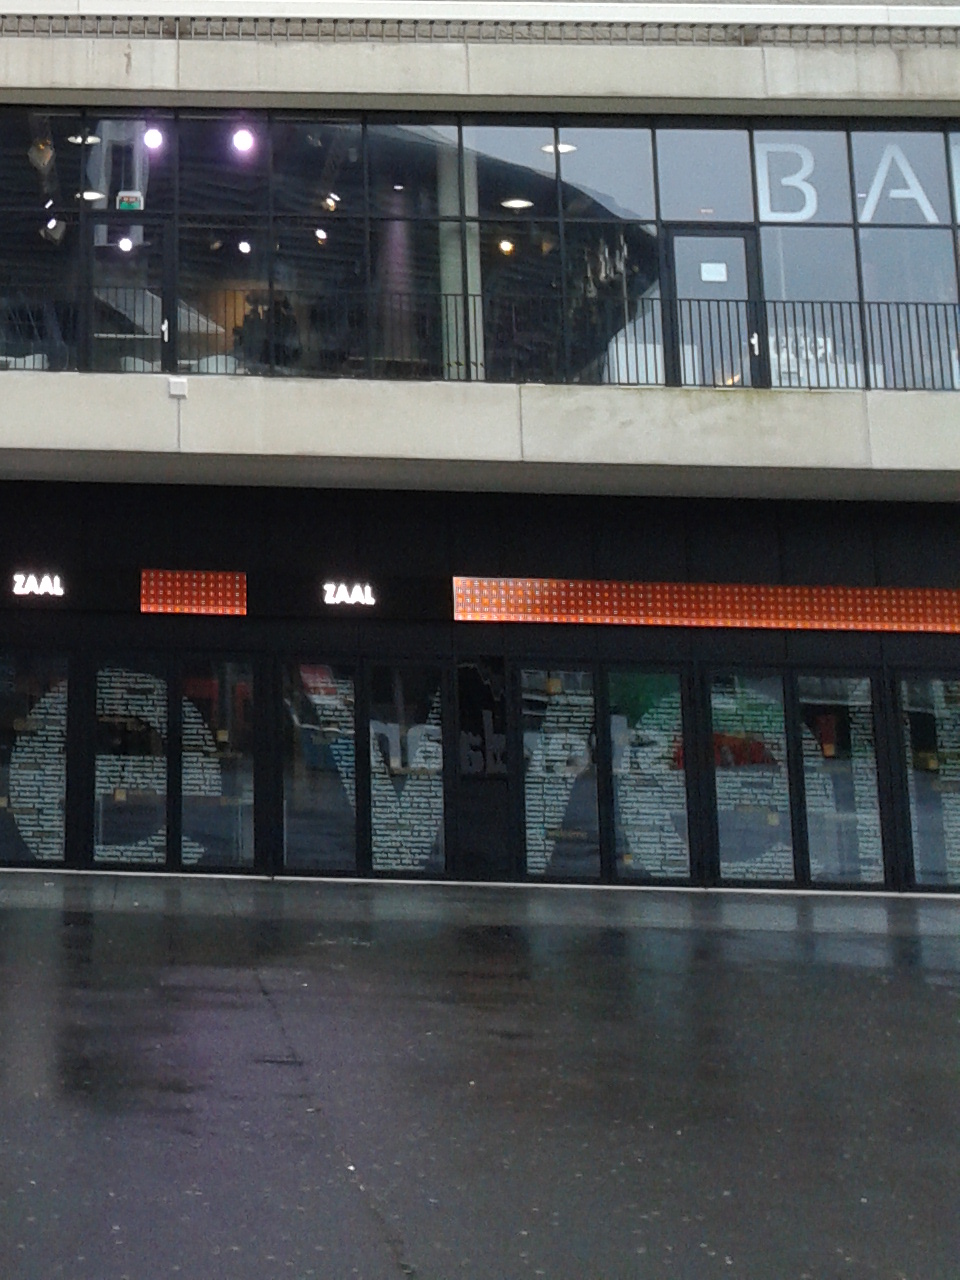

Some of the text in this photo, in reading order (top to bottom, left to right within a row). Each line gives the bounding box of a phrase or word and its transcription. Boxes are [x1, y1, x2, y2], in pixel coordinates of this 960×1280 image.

[754, 142, 960, 223] BA
[12, 573, 65, 597] ZAAL
[322, 581, 376, 606] ZAAL
